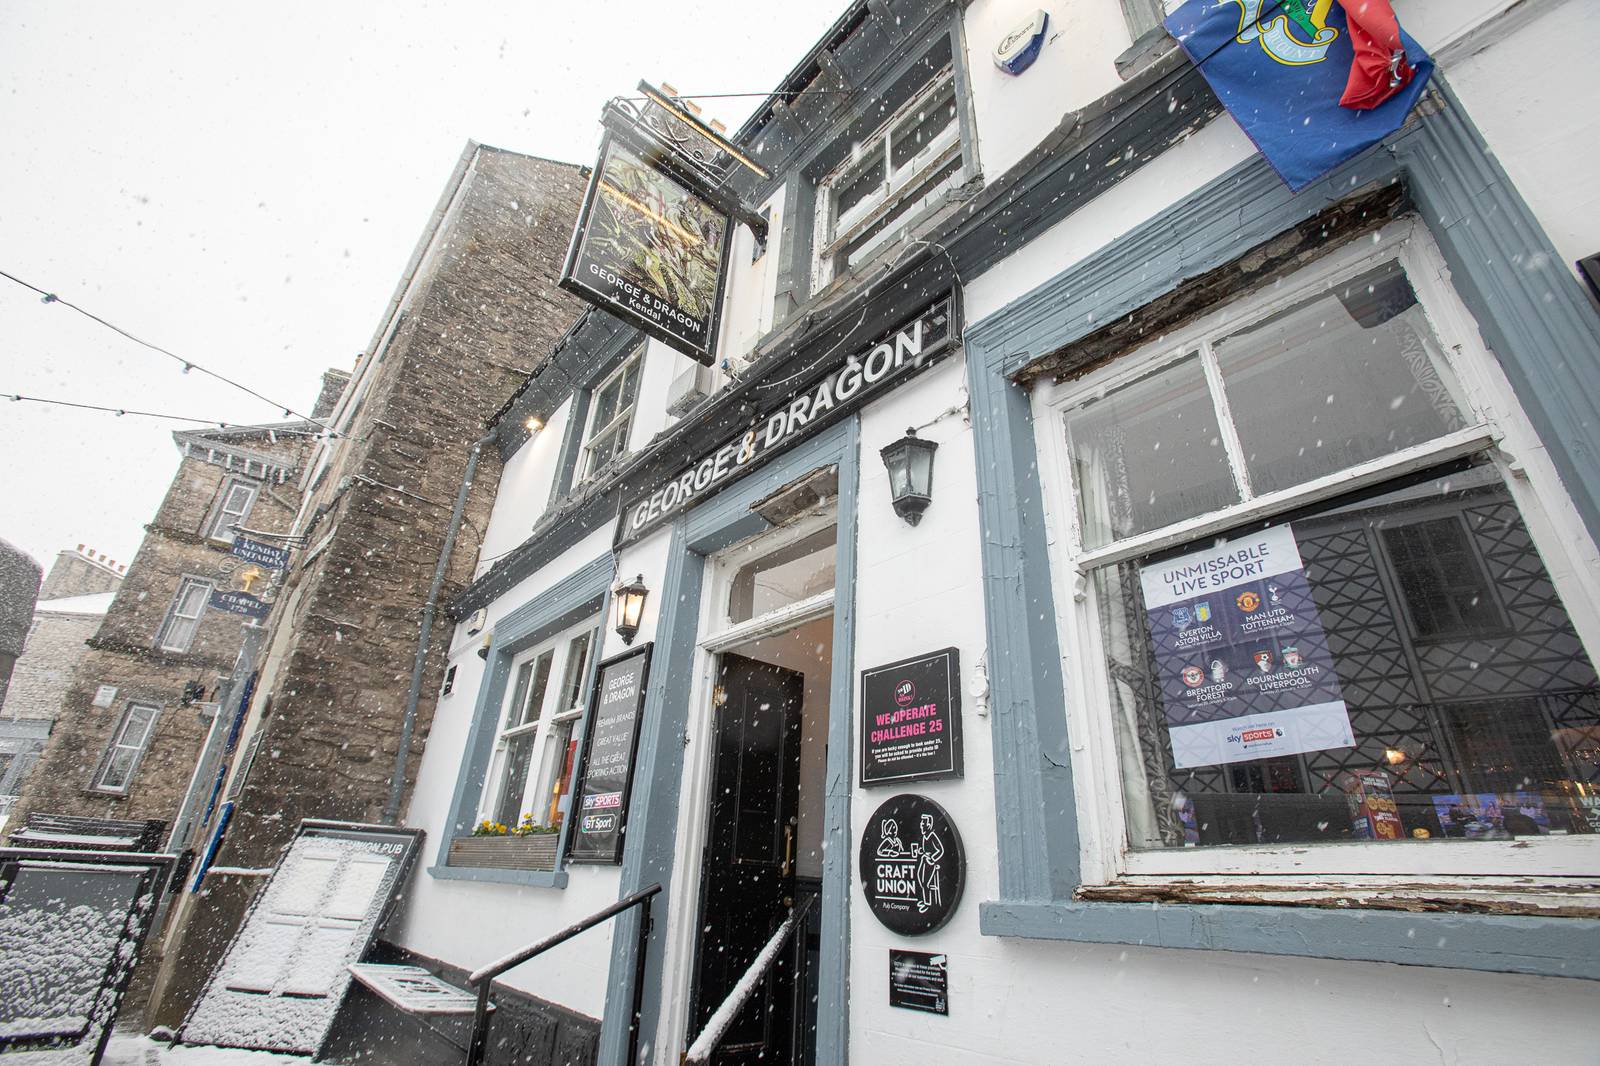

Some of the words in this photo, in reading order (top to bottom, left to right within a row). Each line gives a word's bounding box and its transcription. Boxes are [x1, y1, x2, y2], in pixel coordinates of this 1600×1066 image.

[590, 263, 642, 298] GEORGE
[643, 294, 652, 305] &
[653, 299, 701, 333] DRAGON
[629, 297, 661, 321] Kendal
[632, 446, 738, 530] GEORGE
[737, 431, 757, 465] &
[764, 320, 924, 449] DRAGON
[1163, 542, 1270, 585] UNMISSABLE
[1173, 575, 1208, 596] LIVE
[1212, 559, 1265, 586] SPORT
[221, 594, 262, 609] CHAPEL
[1240, 614, 1295, 630] TOTTENHAM
[1245, 612, 1266, 622] MAN
[1268, 608, 1286, 618] UTD
[1174, 635, 1200, 647] ASTON
[1200, 631, 1222, 640] VILLA
[1179, 625, 1213, 639] EVERTON
[608, 672, 635, 690] GEORGE
[1246, 666, 1320, 685] BOURNEMOUTH
[1259, 676, 1311, 691] LIVERPOOL
[603, 695, 609, 704] &
[609, 685, 636, 703] DRAGON
[1186, 682, 1233, 697] BRENTFORD
[1196, 691, 1226, 702] FOREST
[597, 717, 616, 729] PREMIUM
[615, 710, 636, 724] BRANDS
[876, 712, 891, 727] WE
[893, 703, 937, 723] OPERATE
[597, 736, 613, 747] GREAT
[612, 731, 629, 743] VALUE
[870, 724, 926, 743] CHALLENGE
[929, 719, 943, 734] 25
[1227, 734, 1241, 743] sky
[1243, 729, 1273, 741] sports
[593, 757, 601, 766] ALL
[610, 750, 625, 763] GREAT
[587, 766, 609, 779] SPORTING
[608, 764, 628, 776] ACTION
[594, 793, 621, 807] SPORTS
[586, 818, 595, 829] BT
[595, 816, 613, 829] Sport
[382, 843, 404, 854] PUB
[876, 864, 916, 879] CRAFT
[876, 879, 916, 895] UNION
[882, 902, 891, 910] Pub
[891, 903, 910, 911] Company
